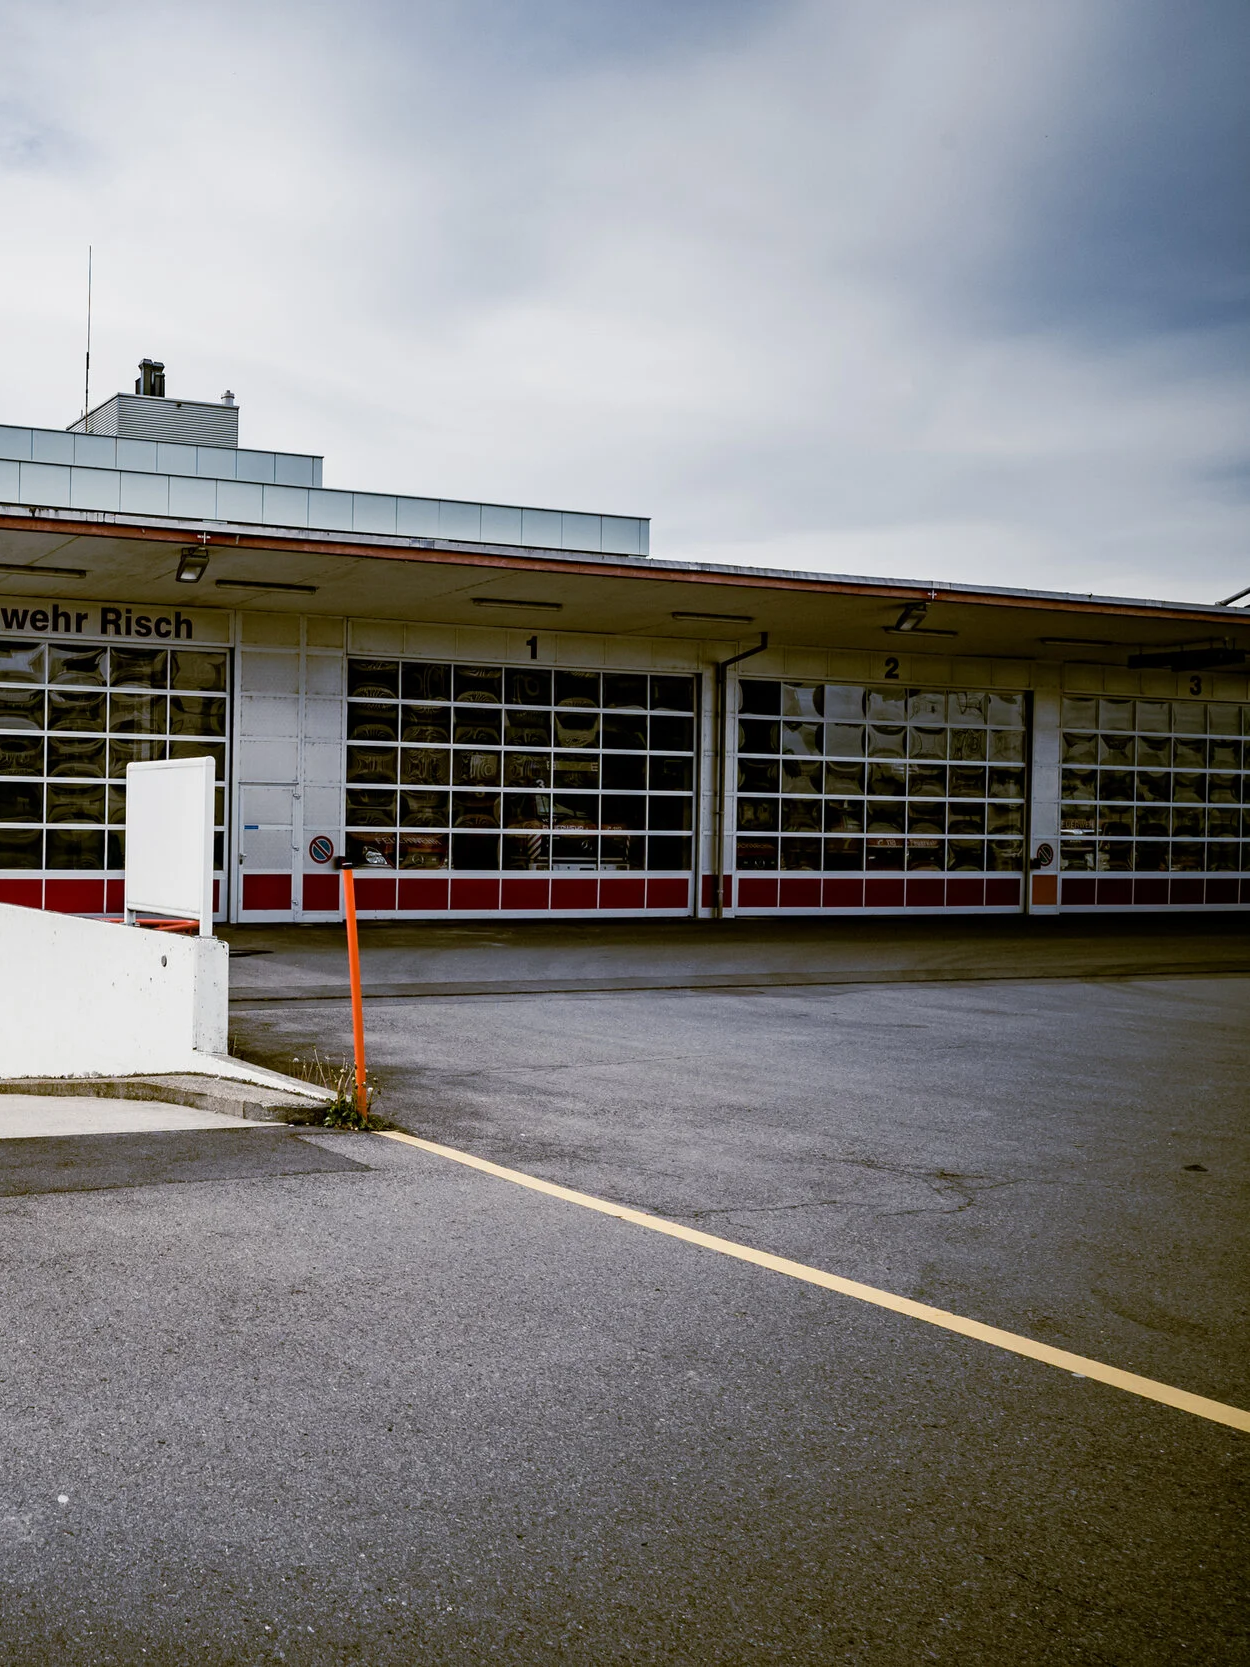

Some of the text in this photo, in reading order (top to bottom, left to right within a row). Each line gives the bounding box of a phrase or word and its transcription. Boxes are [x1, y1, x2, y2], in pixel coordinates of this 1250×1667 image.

[100, 607, 193, 639] Risch
[525, 636, 538, 660] 1
[884, 657, 899, 680] 2
[1189, 675, 1202, 696] 3
